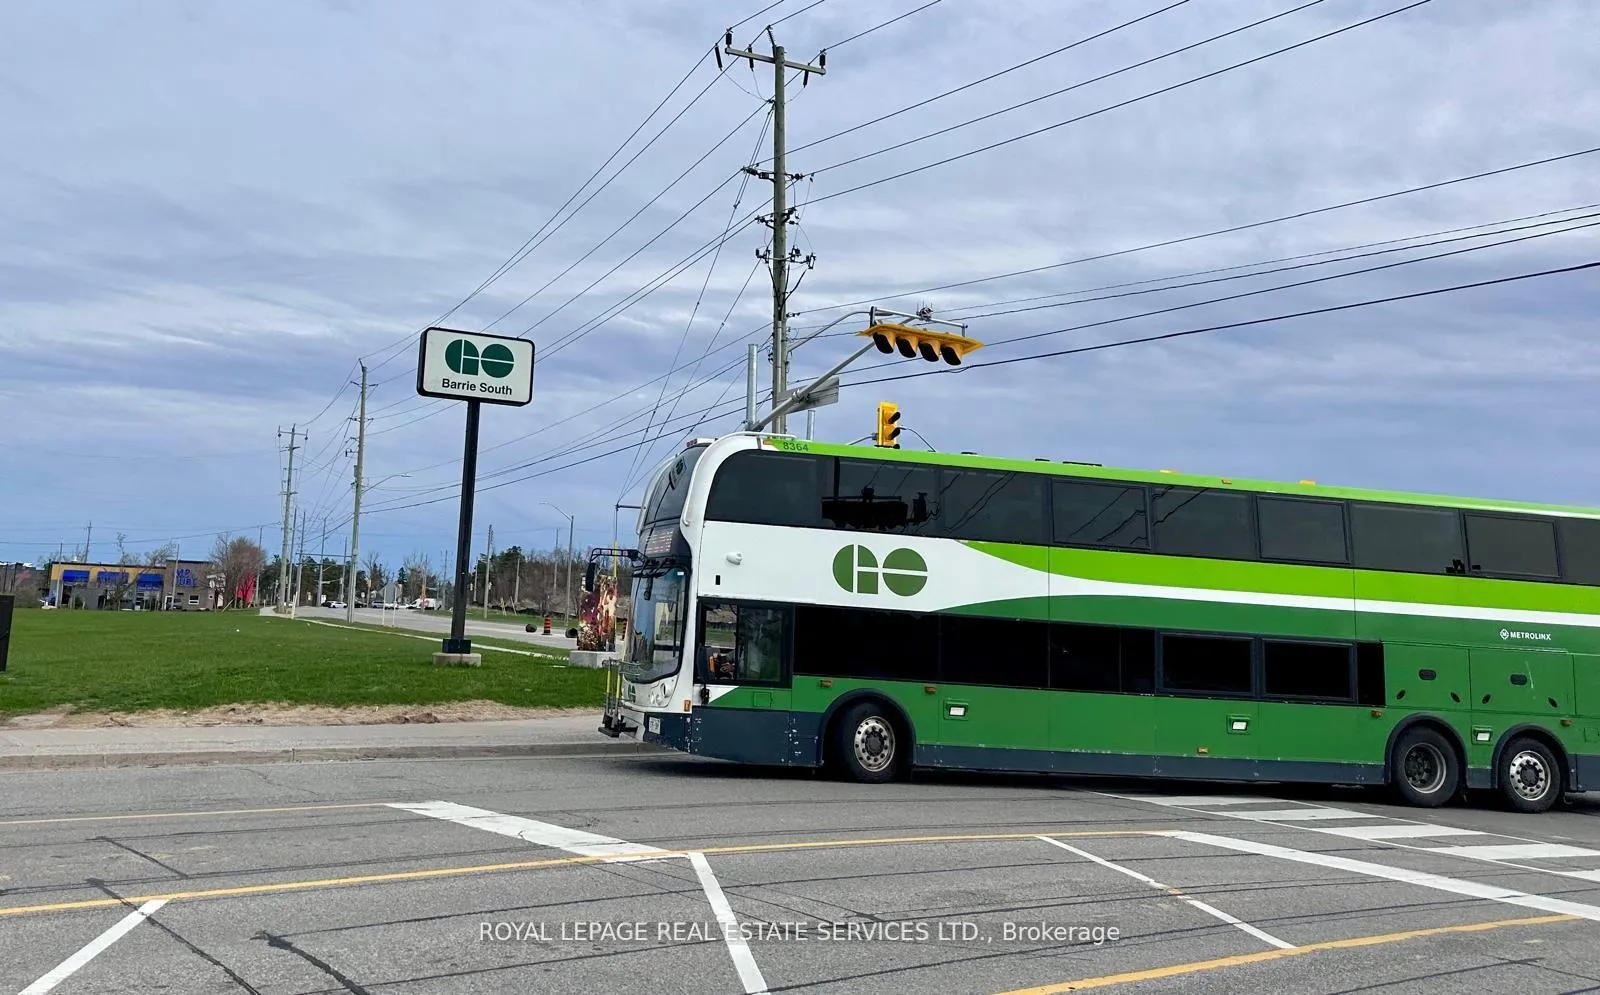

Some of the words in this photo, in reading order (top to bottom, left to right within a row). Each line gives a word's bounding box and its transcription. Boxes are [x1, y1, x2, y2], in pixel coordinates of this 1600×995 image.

[445, 339, 515, 378] GO
[442, 379, 476, 391] Barrie
[479, 383, 512, 395] South
[783, 442, 809, 452] 8364
[832, 543, 928, 597] GO
[1510, 632, 1551, 640] METROLINX
